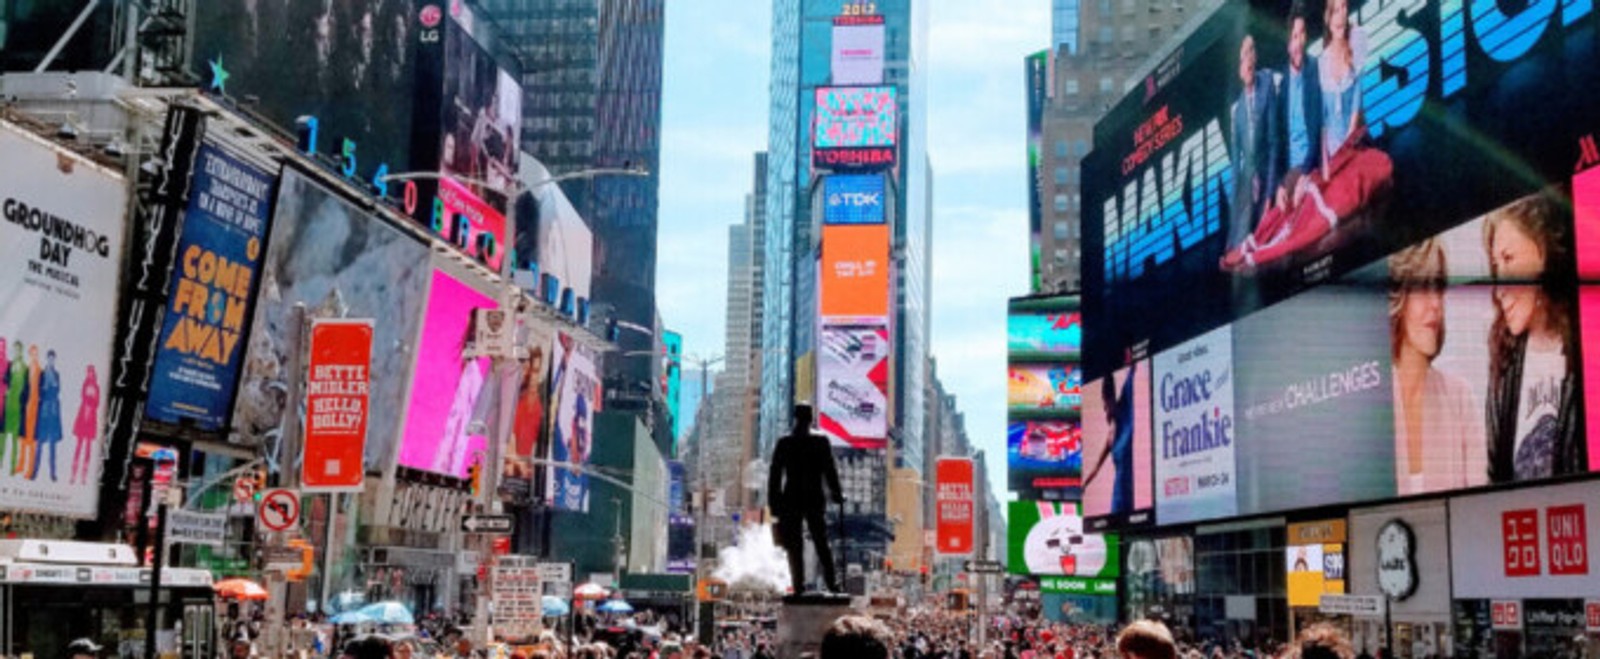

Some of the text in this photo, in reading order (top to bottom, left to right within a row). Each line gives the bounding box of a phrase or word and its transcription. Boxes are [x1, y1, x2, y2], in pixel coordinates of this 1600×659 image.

[420, 30, 440, 42] LG
[815, 149, 893, 163] TOSHIBA
[842, 192, 879, 206] TDK
[2, 197, 110, 258] GROUNDHOG
[39, 237, 72, 268] DAY
[28, 260, 79, 288] THE MUSICAL
[183, 244, 253, 300] COME
[173, 277, 247, 334] FROM
[165, 316, 240, 366] AWAY
[314, 365, 366, 380] BETTE
[1284, 360, 1381, 409] CHALLENGES
[310, 381, 369, 395] MIDLER
[1160, 369, 1212, 413] Grace
[1163, 406, 1232, 460] Frankie
[1550, 513, 1580, 539] UNI
[1552, 541, 1584, 571] QLO
[1056, 581, 1086, 590] SOON
